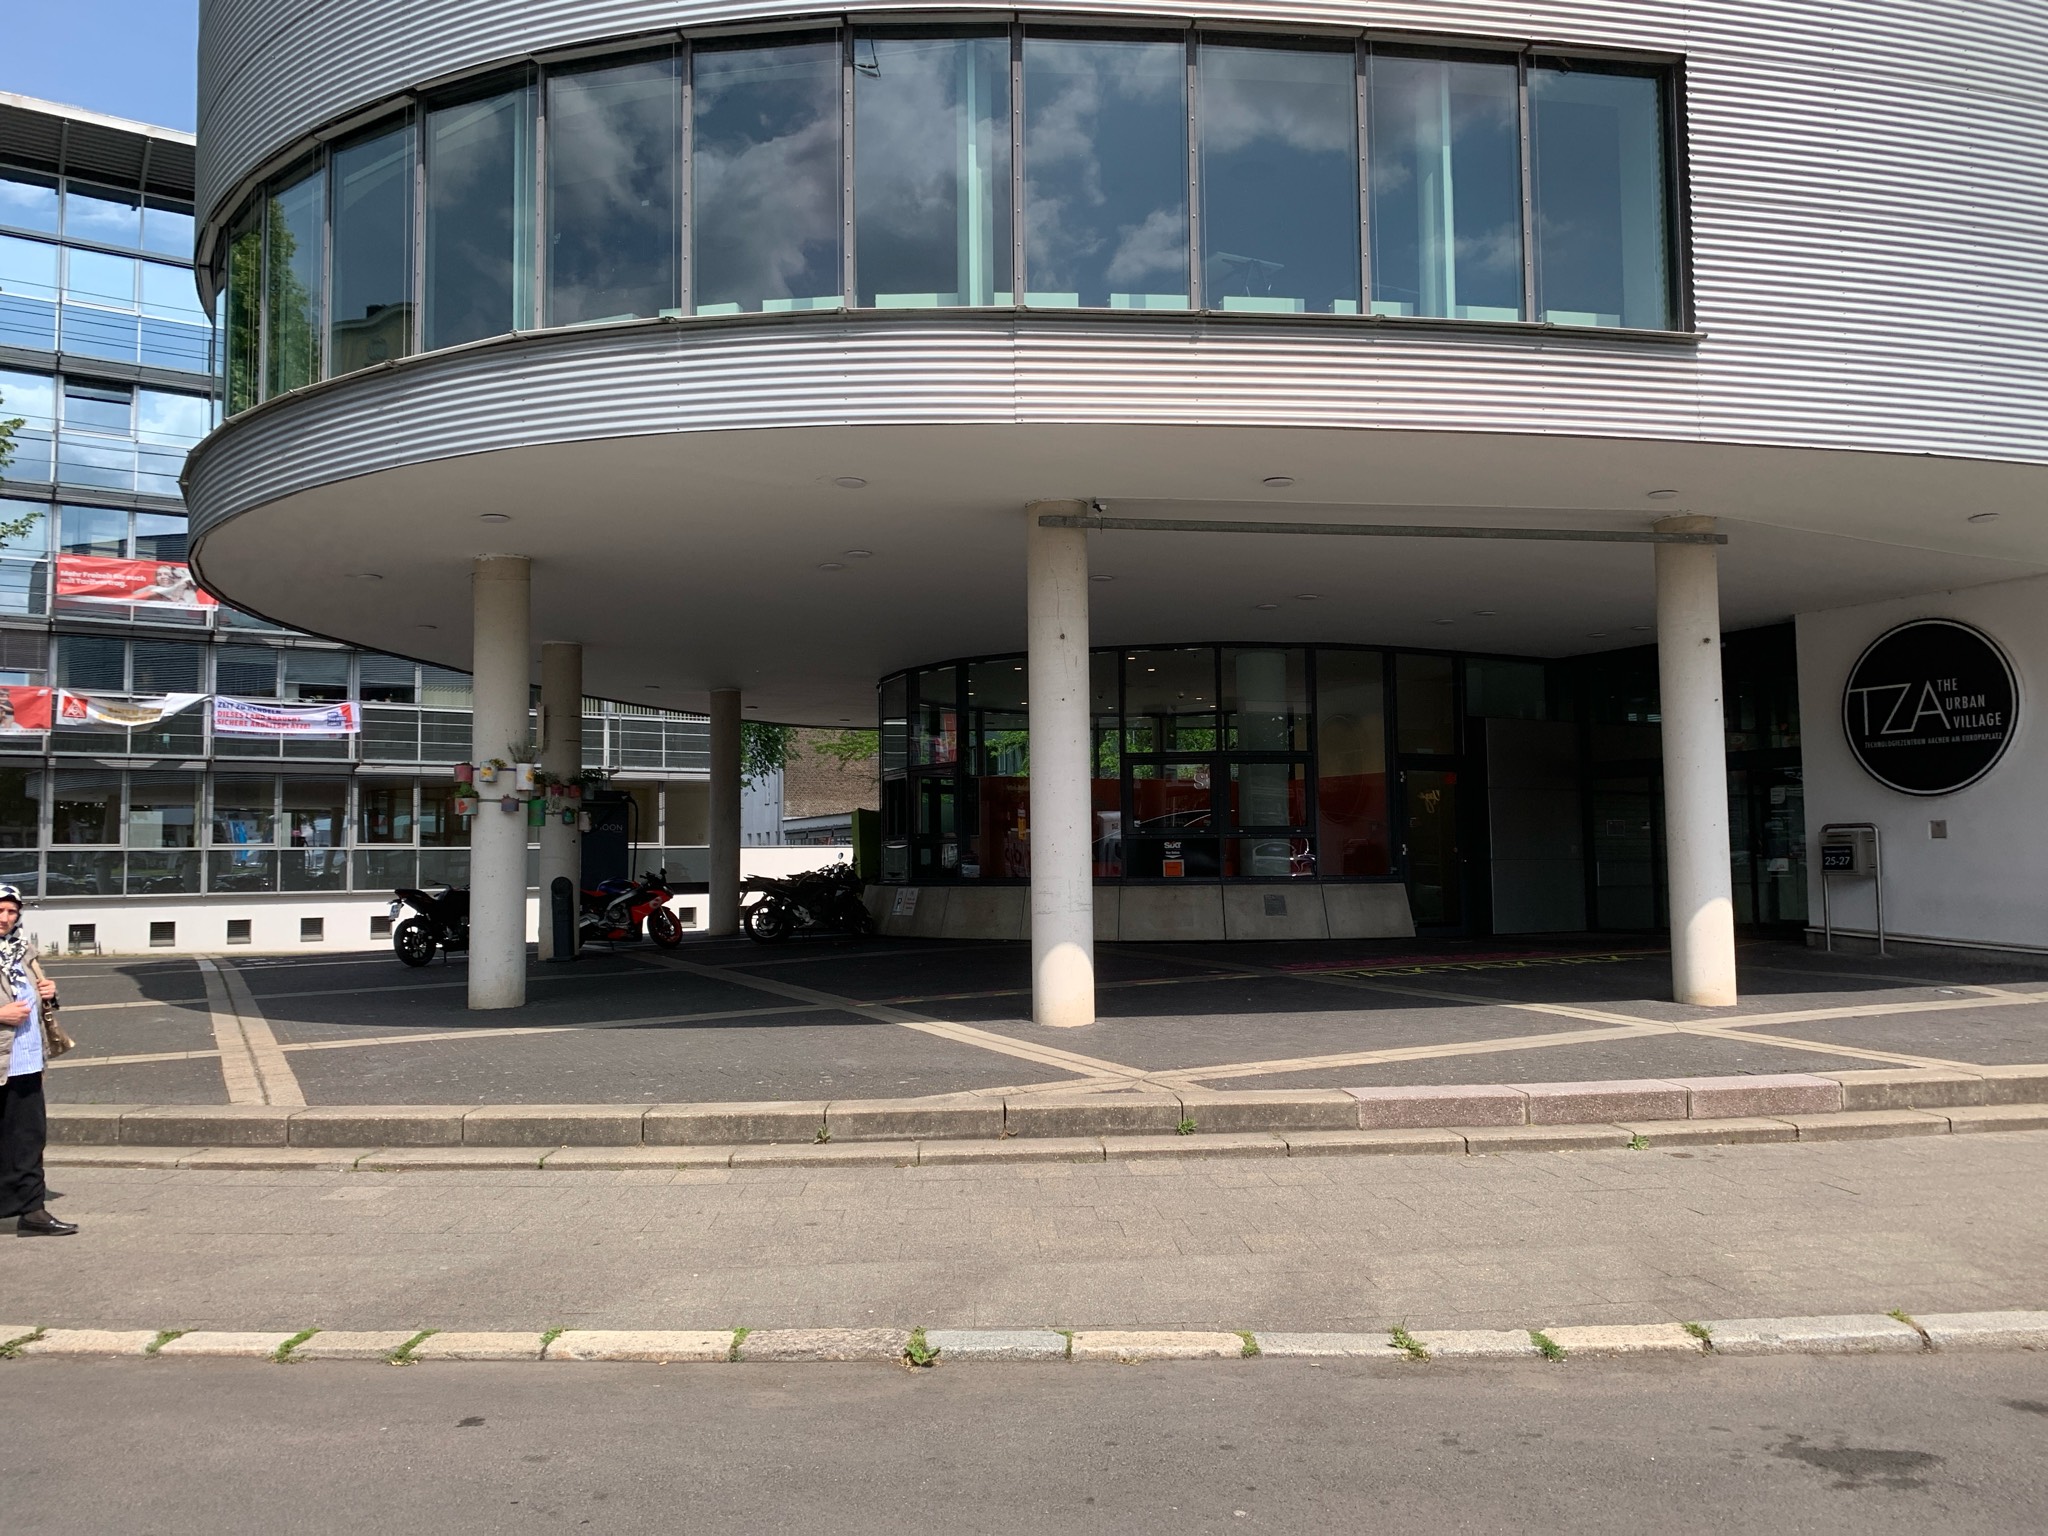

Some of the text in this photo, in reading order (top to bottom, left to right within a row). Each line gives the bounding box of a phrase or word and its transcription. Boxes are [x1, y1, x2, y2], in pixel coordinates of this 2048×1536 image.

[1936, 678, 1959, 692] THE
[217, 701, 235, 709] ZEIT
[1848, 680, 1951, 736] TZA
[1945, 694, 1986, 710] URBAN
[217, 710, 244, 718] DIESES
[1952, 711, 2003, 729] VILLAGE
[217, 718, 248, 727] SICHERE
[1927, 736, 1950, 745] AACHEN
[1951, 735, 1961, 743] AM
[1961, 732, 2003, 742] EUROPAPLATZ
[1163, 841, 1182, 849] SIXT
[1825, 856, 1850, 866] 25-27
[896, 897, 902, 910] P
